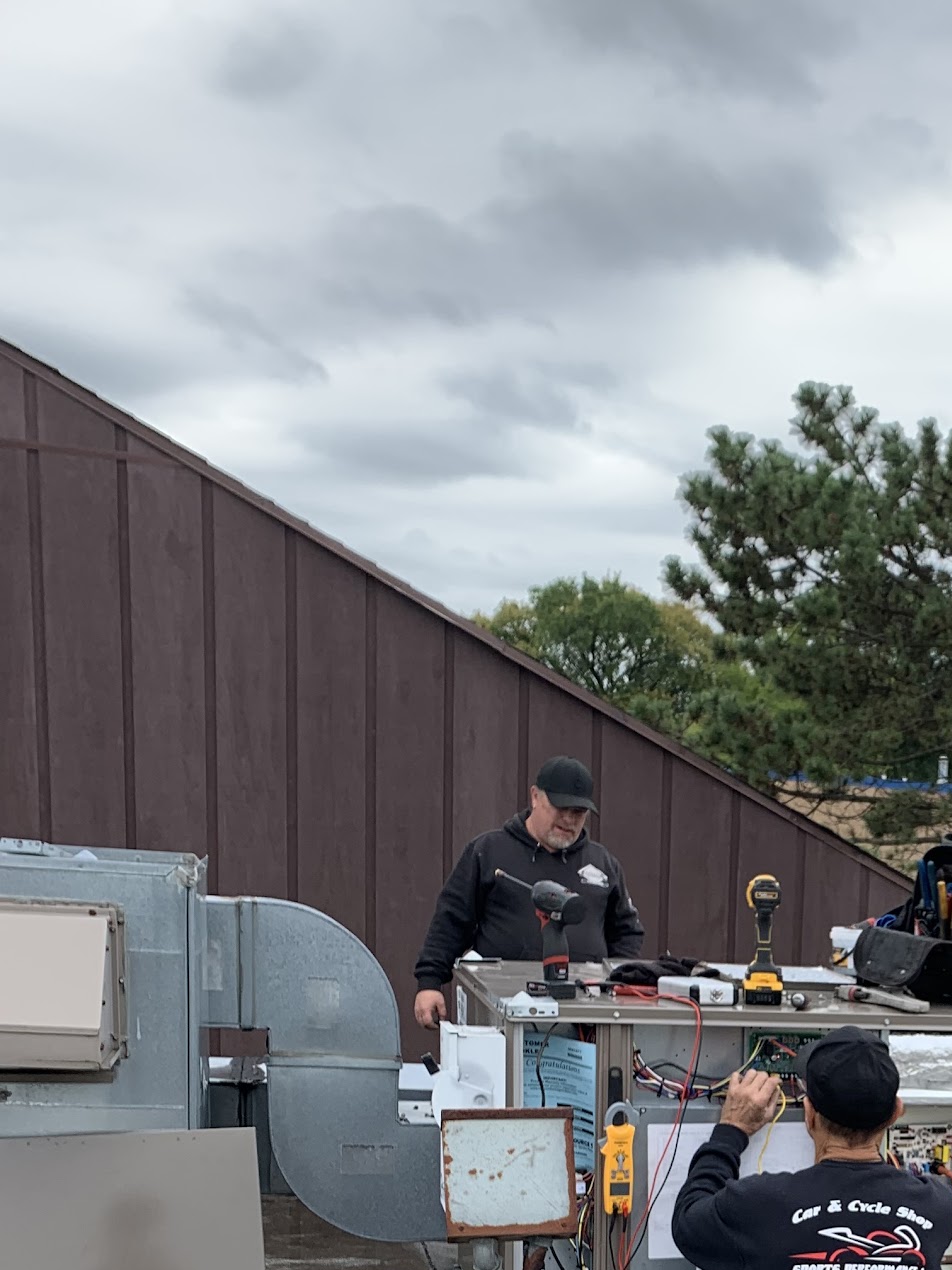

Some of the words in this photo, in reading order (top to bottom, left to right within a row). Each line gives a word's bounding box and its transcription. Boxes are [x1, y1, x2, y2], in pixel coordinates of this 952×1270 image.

[792, 1205, 821, 1224] Car
[827, 1200, 842, 1213] &
[847, 1200, 892, 1215] Cycle
[896, 1206, 933, 1230] Shop
